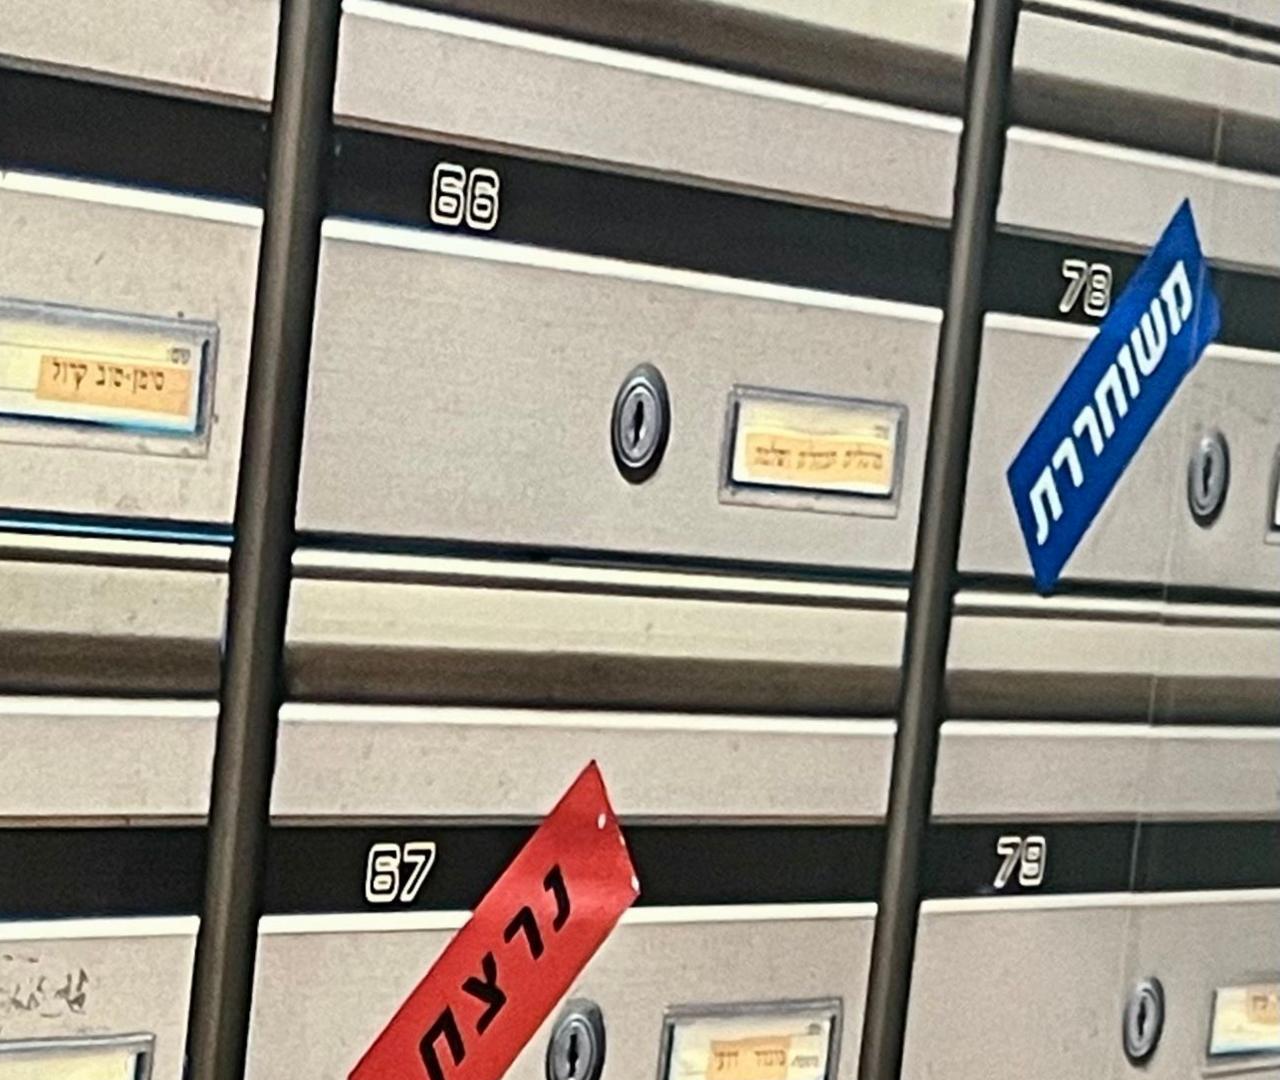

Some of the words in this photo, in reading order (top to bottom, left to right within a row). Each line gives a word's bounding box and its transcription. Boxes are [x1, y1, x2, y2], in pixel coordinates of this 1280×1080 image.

[430, 163, 500, 230] 66
[1060, 260, 1112, 316] 78
[1029, 260, 1194, 546] משוחררת
[365, 842, 436, 902] 67
[993, 836, 1046, 888] 79
